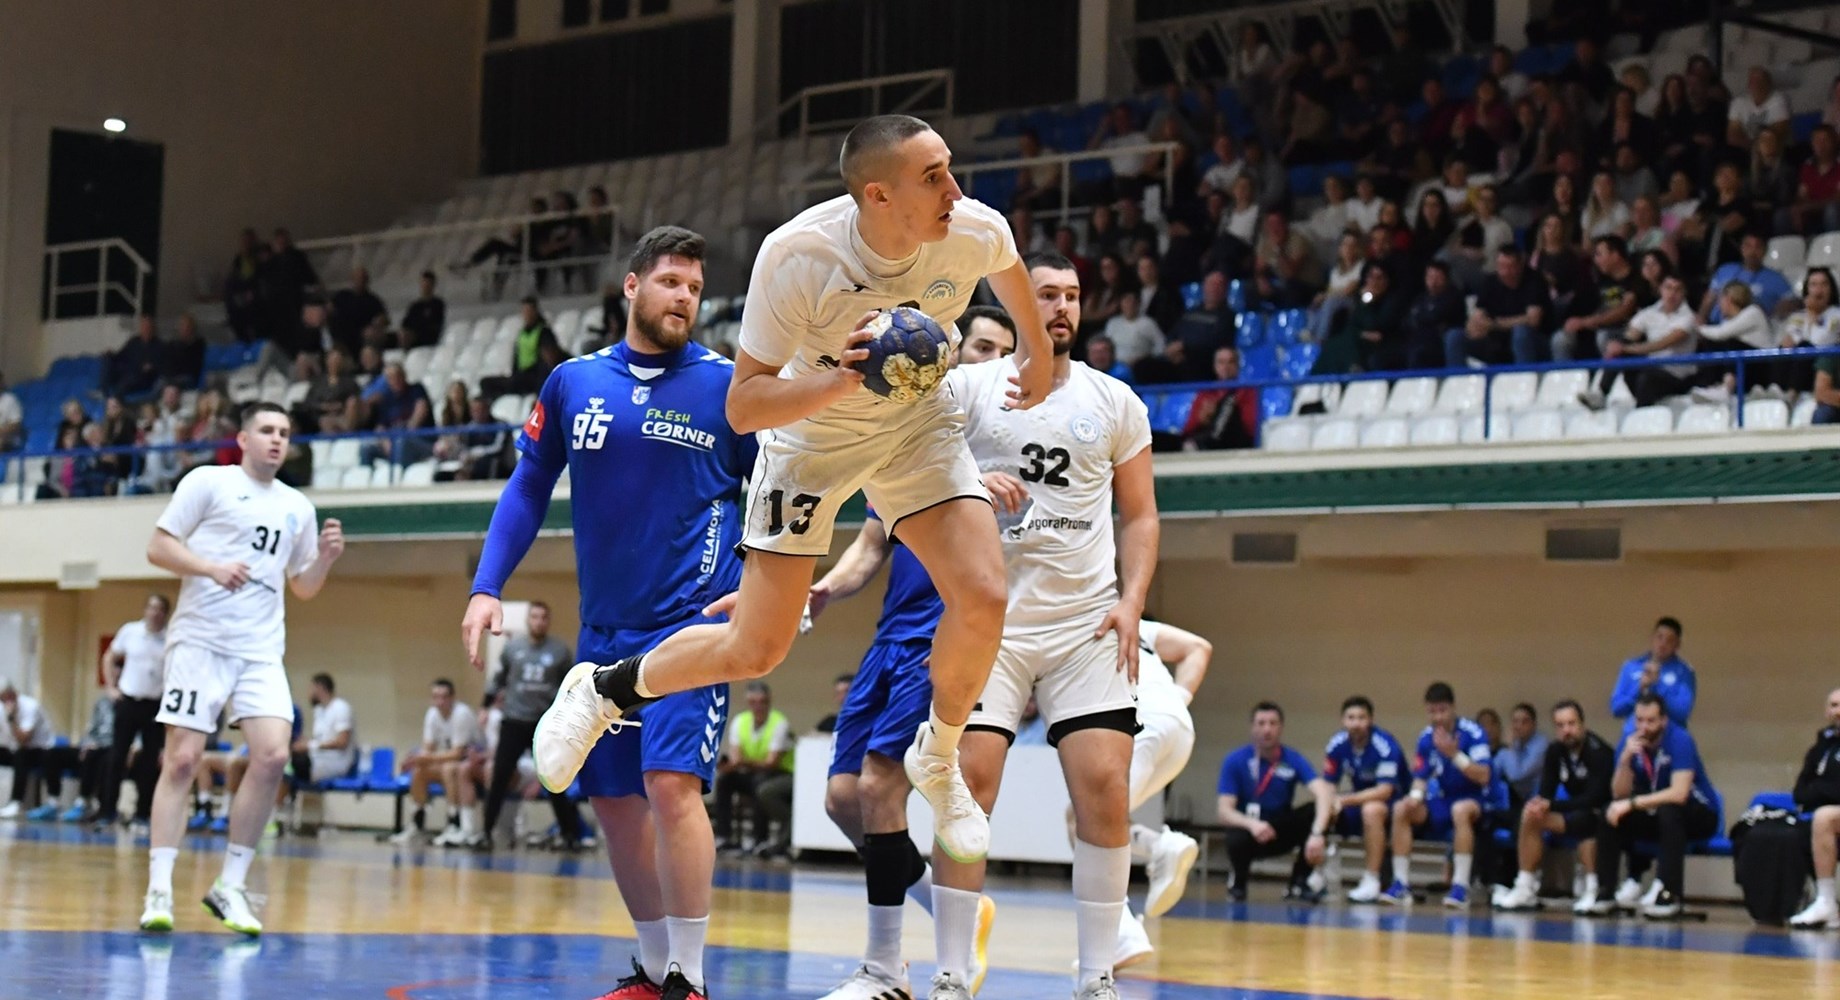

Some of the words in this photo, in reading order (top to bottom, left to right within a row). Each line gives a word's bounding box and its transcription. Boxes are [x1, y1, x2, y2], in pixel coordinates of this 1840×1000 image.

[572, 413, 614, 450] 95
[645, 408, 691, 423] FRESH
[1019, 442, 1071, 487] 32
[768, 489, 822, 536] 13
[251, 525, 281, 555] 31
[700, 499, 721, 574] CELANOVA
[165, 689, 198, 715] 31
